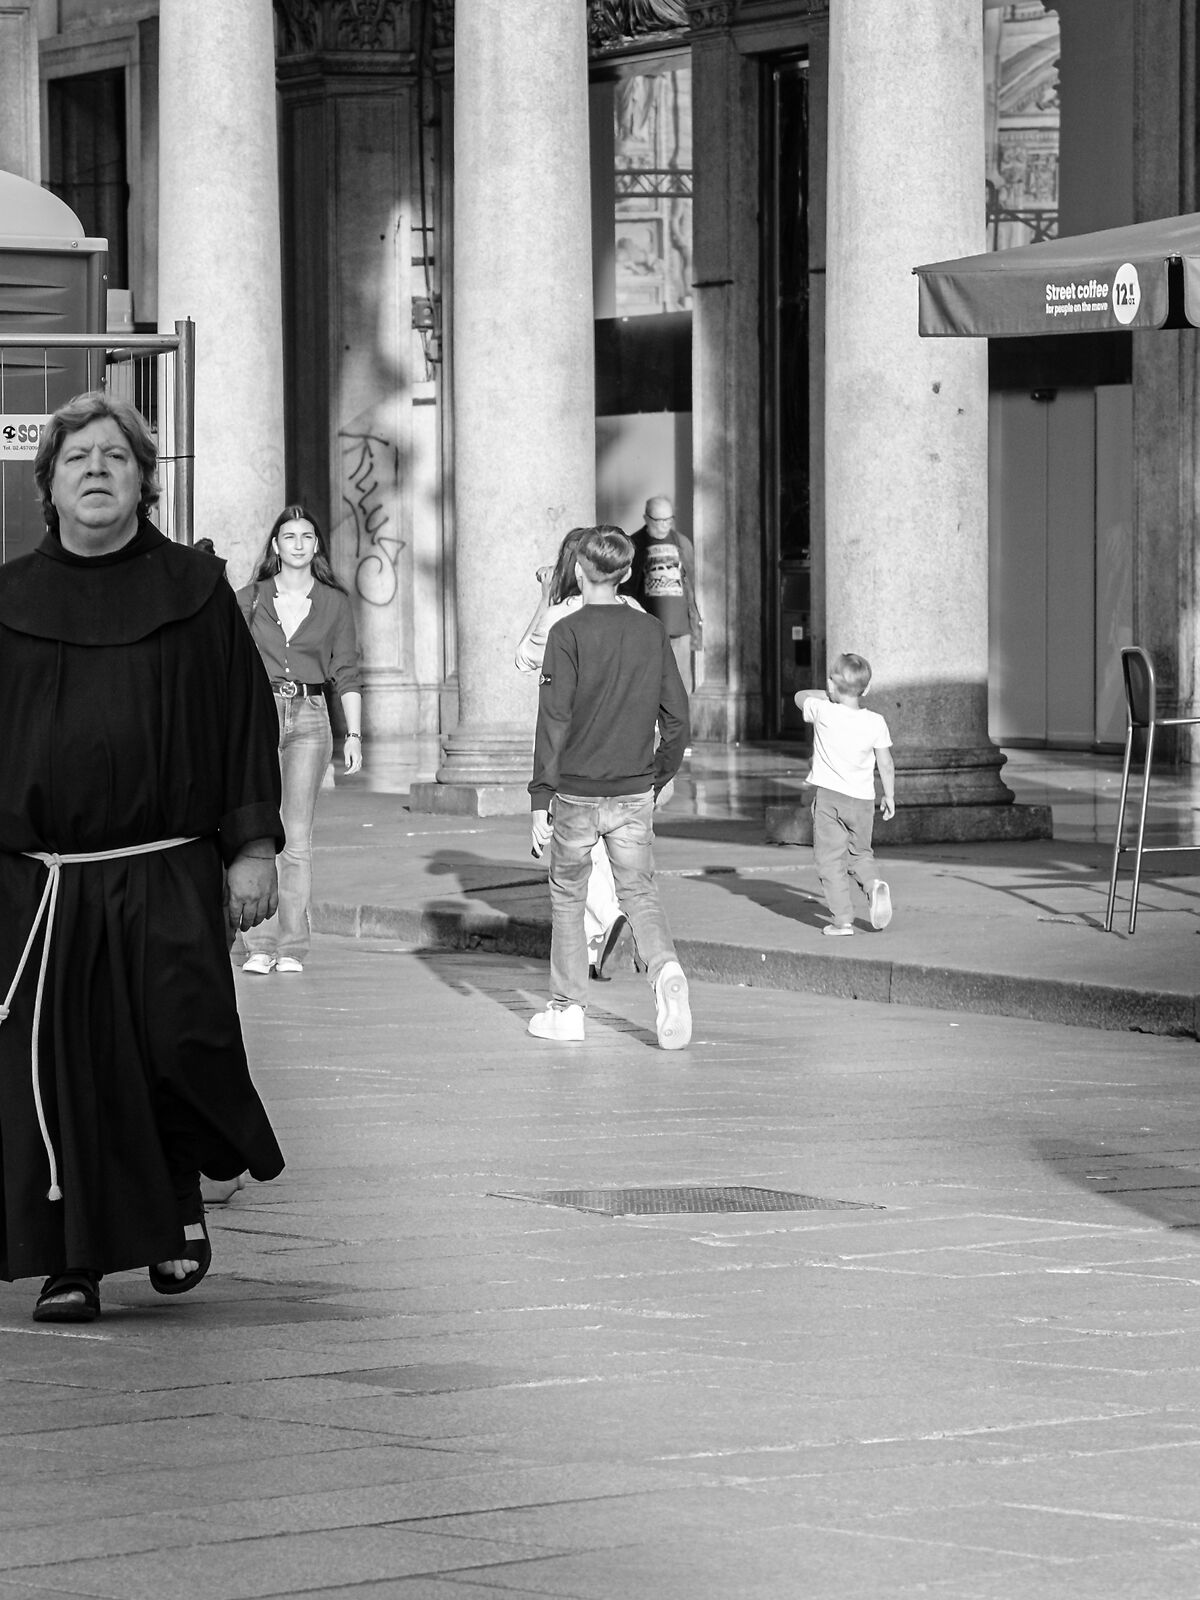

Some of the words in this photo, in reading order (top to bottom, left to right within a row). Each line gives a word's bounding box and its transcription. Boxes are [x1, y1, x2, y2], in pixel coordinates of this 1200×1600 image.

[1046, 283, 1076, 300] Street
[1077, 280, 1109, 299] coffee
[1116, 283, 1128, 305] 12
[1046, 303, 1054, 314] for
[1054, 302, 1074, 316] people
[1074, 303, 1082, 312] on
[1082, 301, 1092, 311] the
[1091, 302, 1108, 311] move
[17, 424, 46, 443] SO
